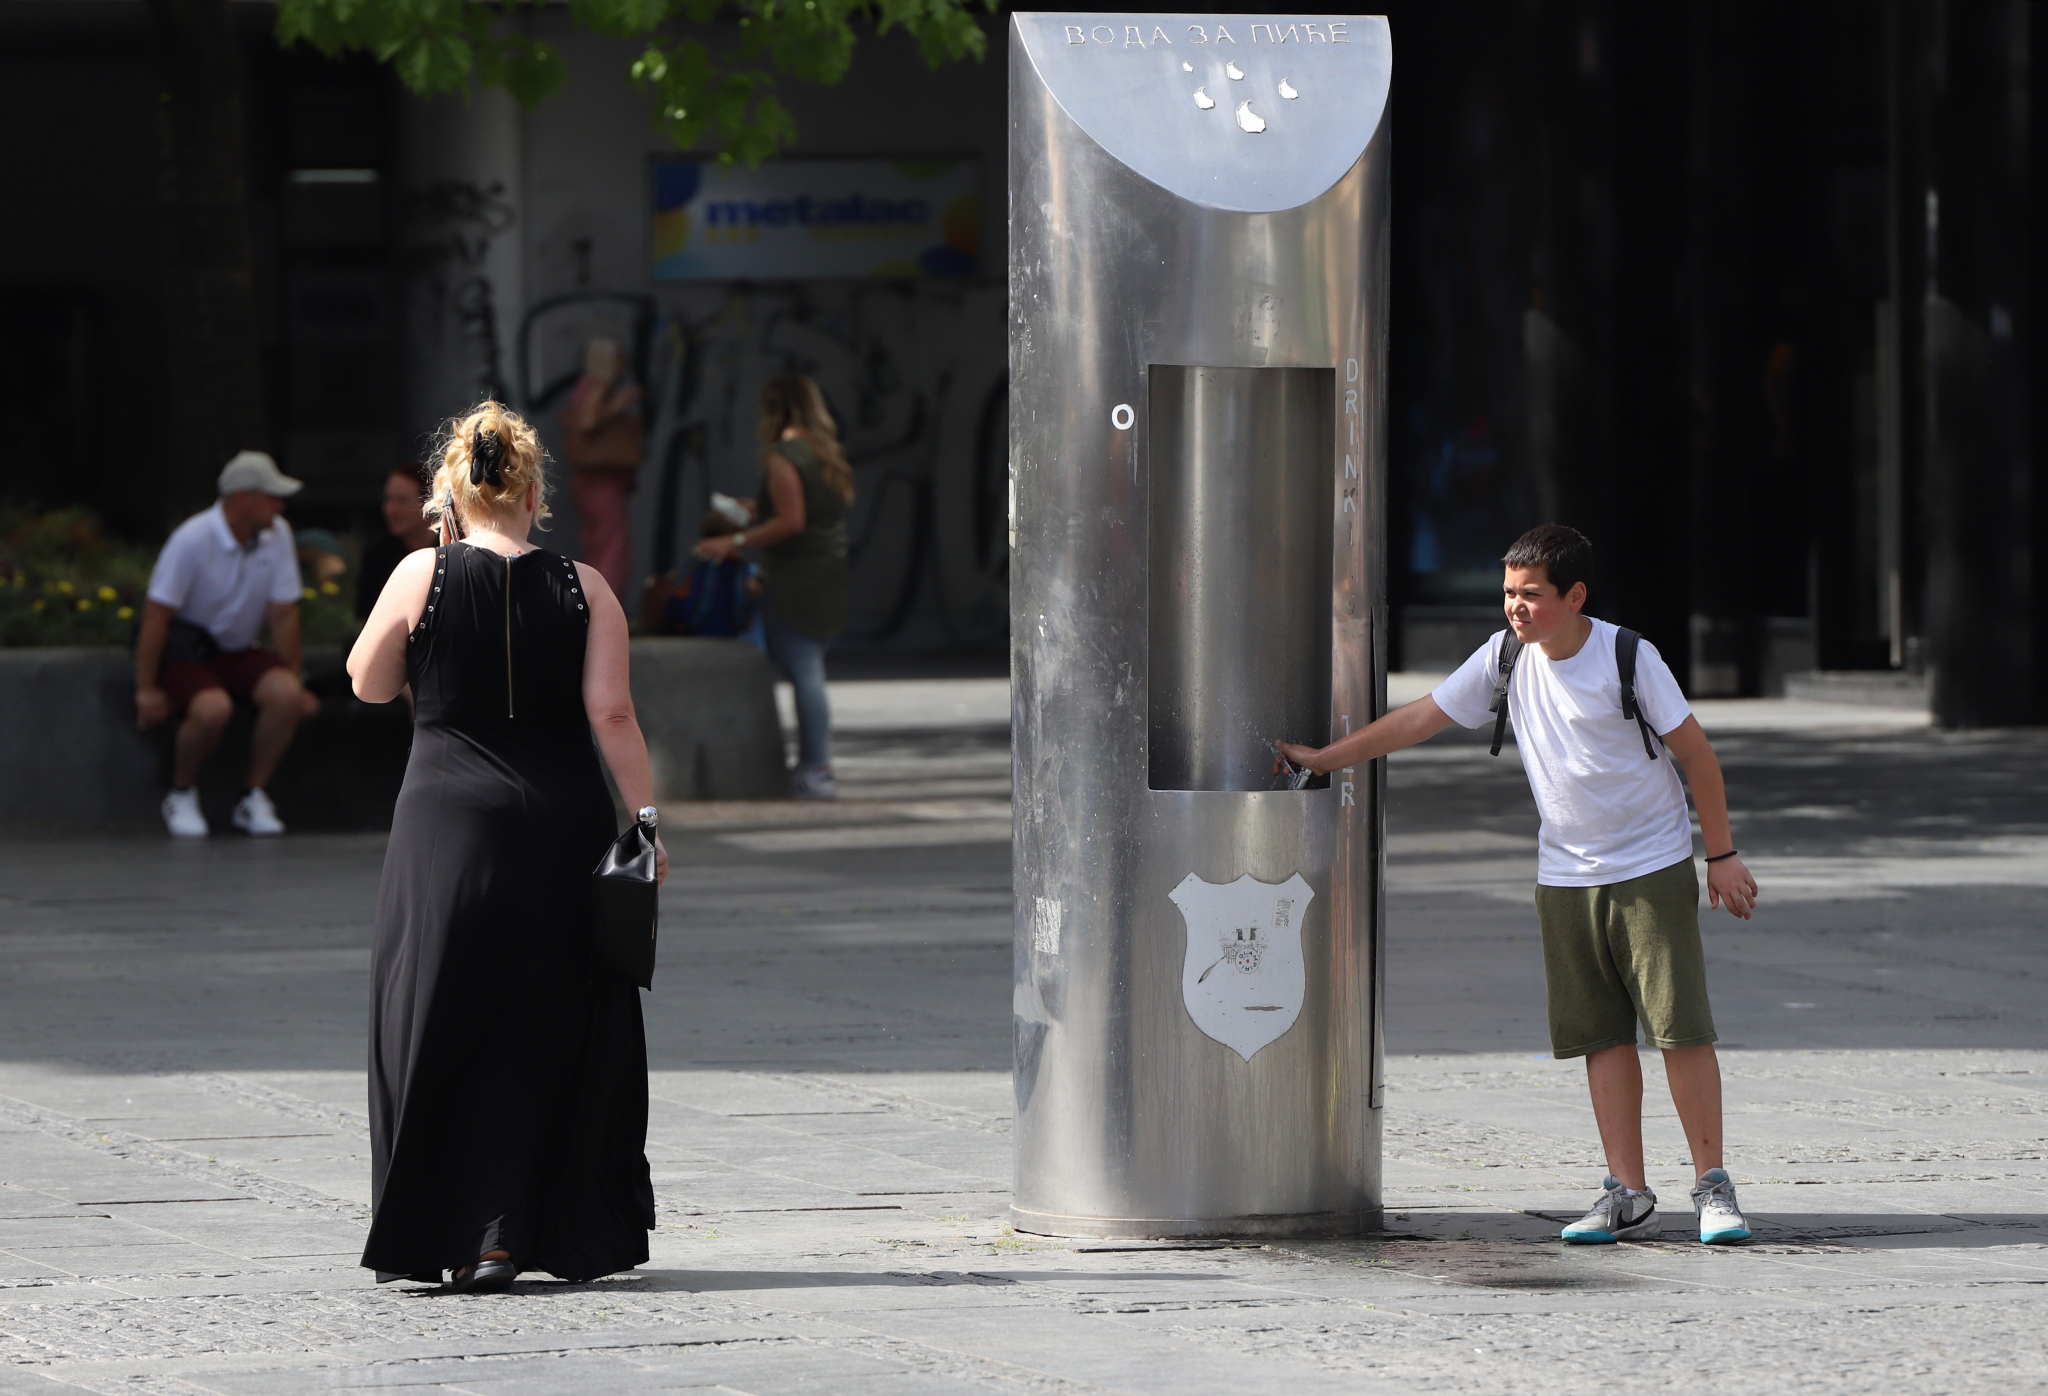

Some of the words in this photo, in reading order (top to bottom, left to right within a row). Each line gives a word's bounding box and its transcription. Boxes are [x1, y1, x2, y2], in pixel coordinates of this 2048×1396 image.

[1064, 25, 1172, 49] ВОДА
[1188, 25, 1236, 44] ЗА
[1250, 23, 1350, 44] ПИЋЕ
[706, 192, 930, 226] metalac
